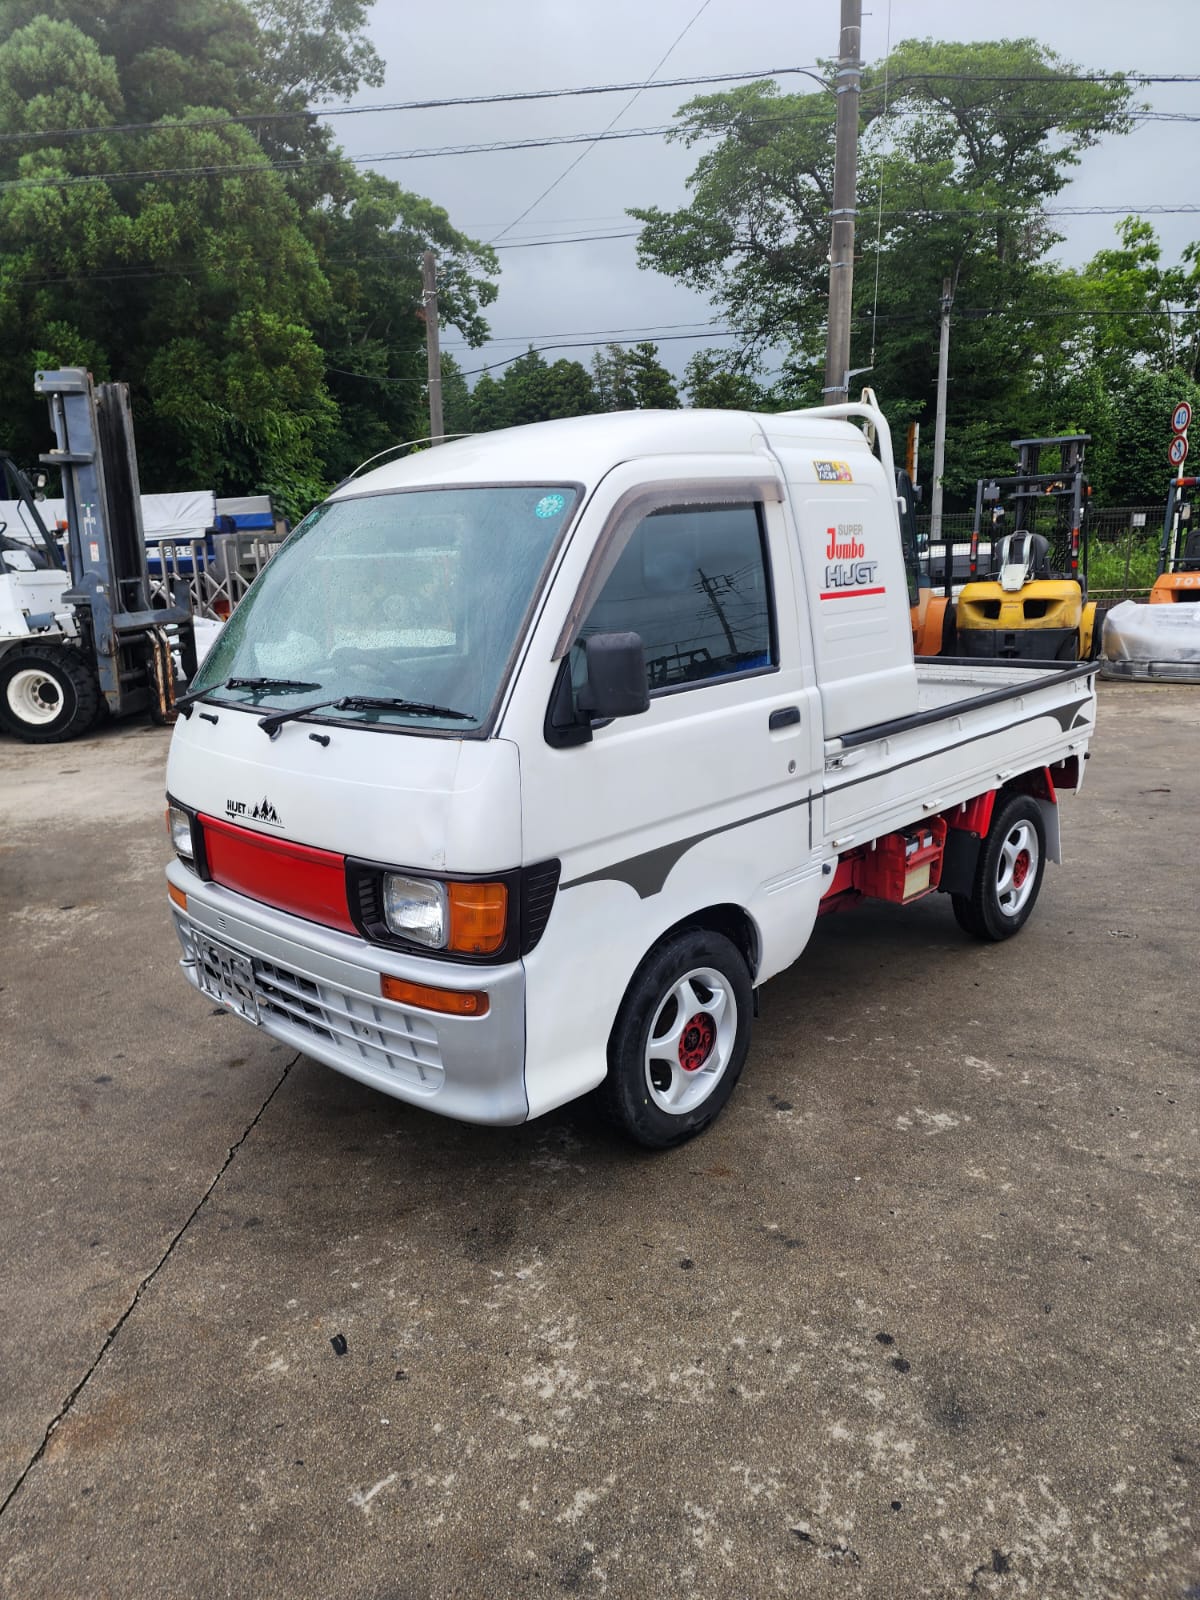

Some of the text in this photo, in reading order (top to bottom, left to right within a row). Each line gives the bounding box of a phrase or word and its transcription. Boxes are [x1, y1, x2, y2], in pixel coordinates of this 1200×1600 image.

[1175, 410, 1187, 425] 40
[838, 524, 863, 535] SUPER
[826, 527, 865, 560] Jumbo
[227, 799, 246, 815] HIJET
